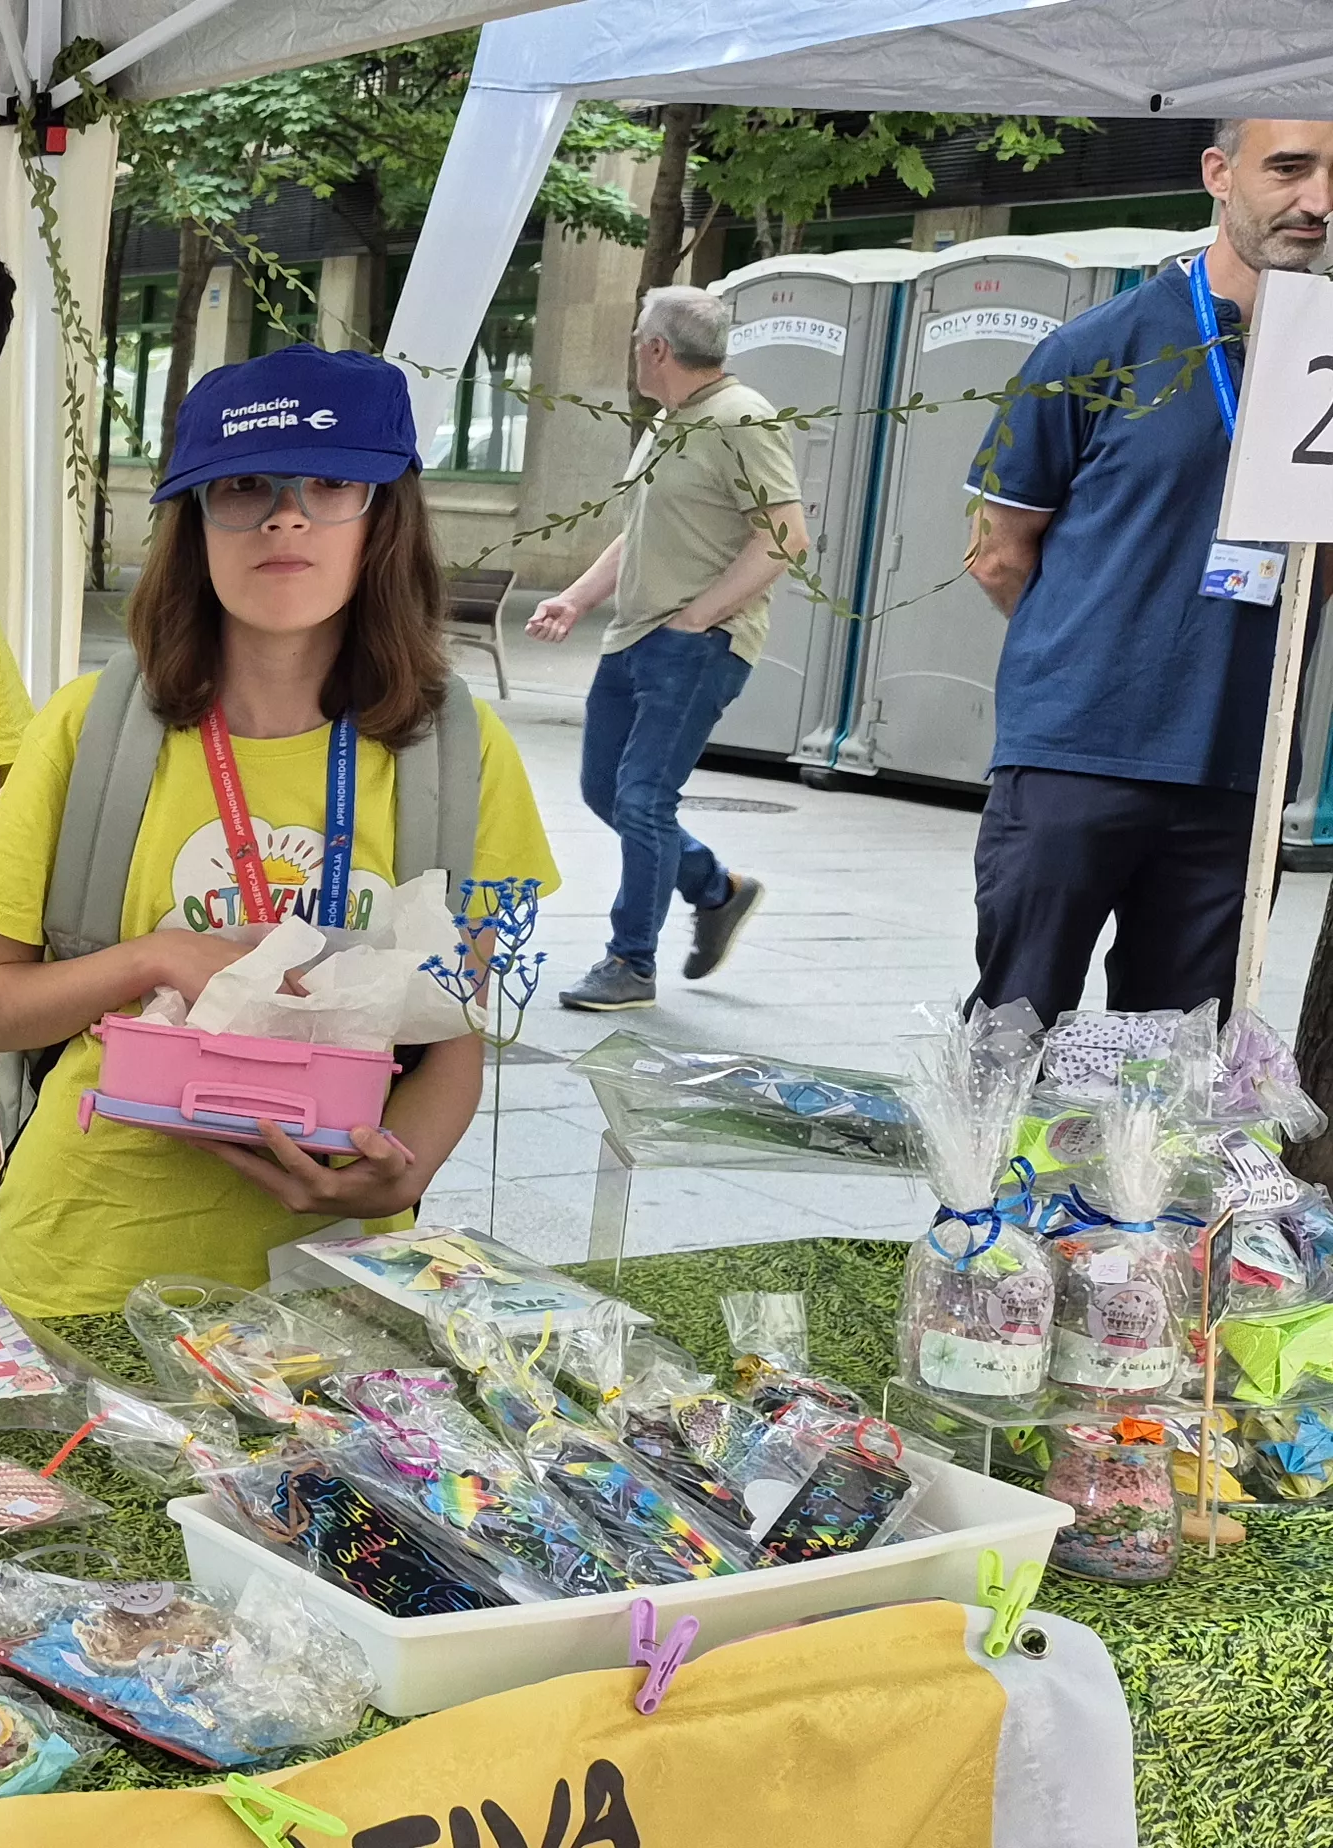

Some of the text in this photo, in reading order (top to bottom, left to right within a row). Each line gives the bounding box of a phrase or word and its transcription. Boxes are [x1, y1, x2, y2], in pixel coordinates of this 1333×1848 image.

[772, 320, 792, 333] 976
[795, 321, 807, 333] 51
[810, 323, 825, 336] 99
[827, 328, 842, 342] 52
[930, 314, 972, 340] ORLY
[976, 312, 1000, 326] 976
[1003, 313, 1016, 326] 51
[1020, 314, 1037, 330] 99
[222, 397, 300, 420] Fundación
[1292, 355, 1333, 465] 2
[222, 411, 299, 438] Ibercaja
[219, 762, 227, 770] A
[338, 748, 347, 756] A
[221, 770, 247, 838] APRENDIENDO
[335, 755, 347, 827] APRENDIENDO
[245, 861, 265, 912] IBERCAJA
[330, 853, 342, 900] IBERCAJA
